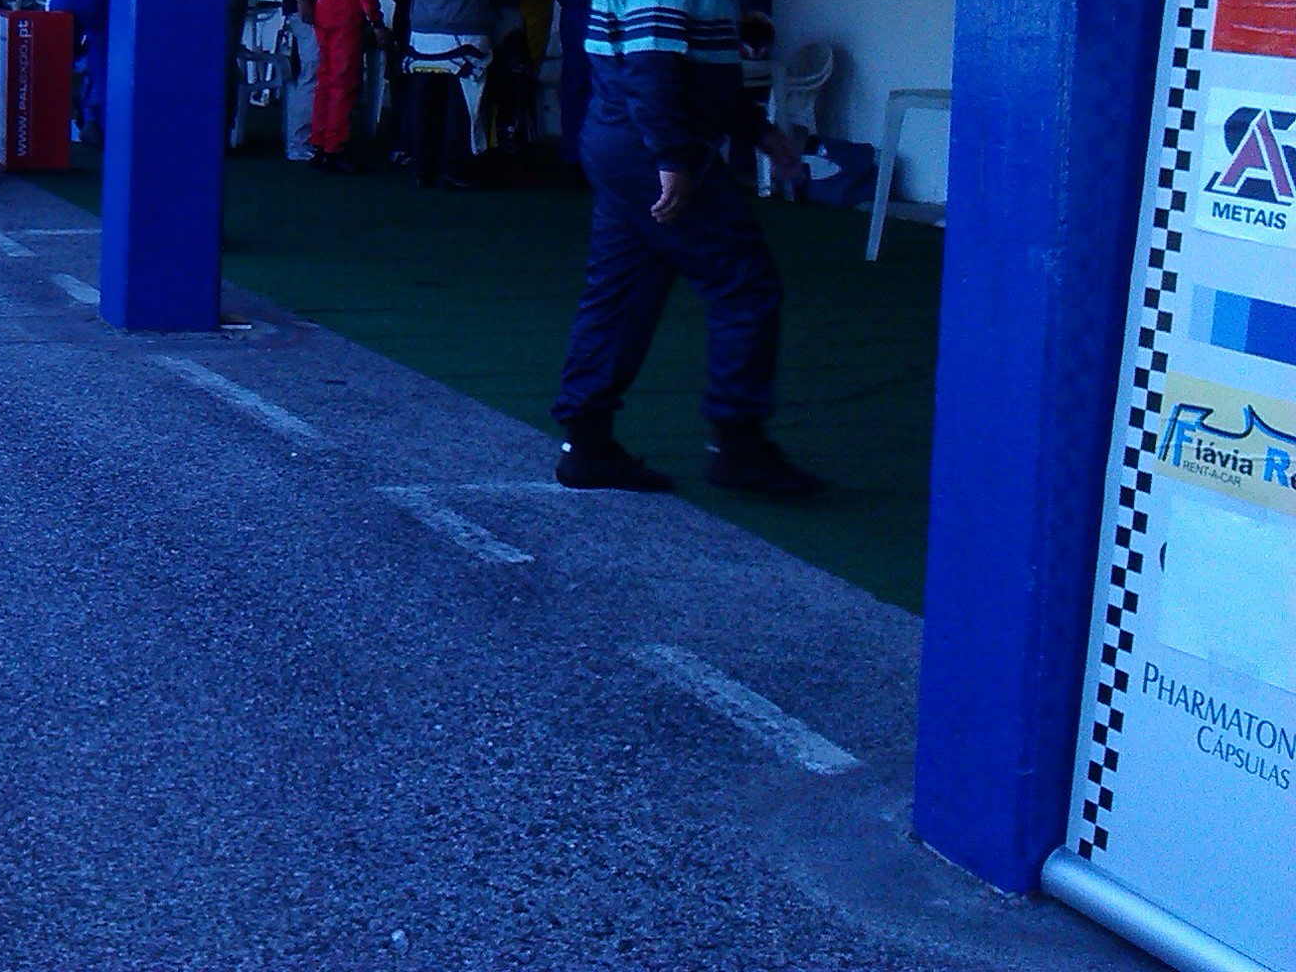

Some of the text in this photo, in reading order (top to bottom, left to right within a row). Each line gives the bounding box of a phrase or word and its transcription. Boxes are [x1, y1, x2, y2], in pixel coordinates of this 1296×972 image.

[1212, 201, 1287, 230] METAIS
[1171, 419, 1253, 477] Flávia
[1182, 459, 1243, 488] RENT-A-CAR
